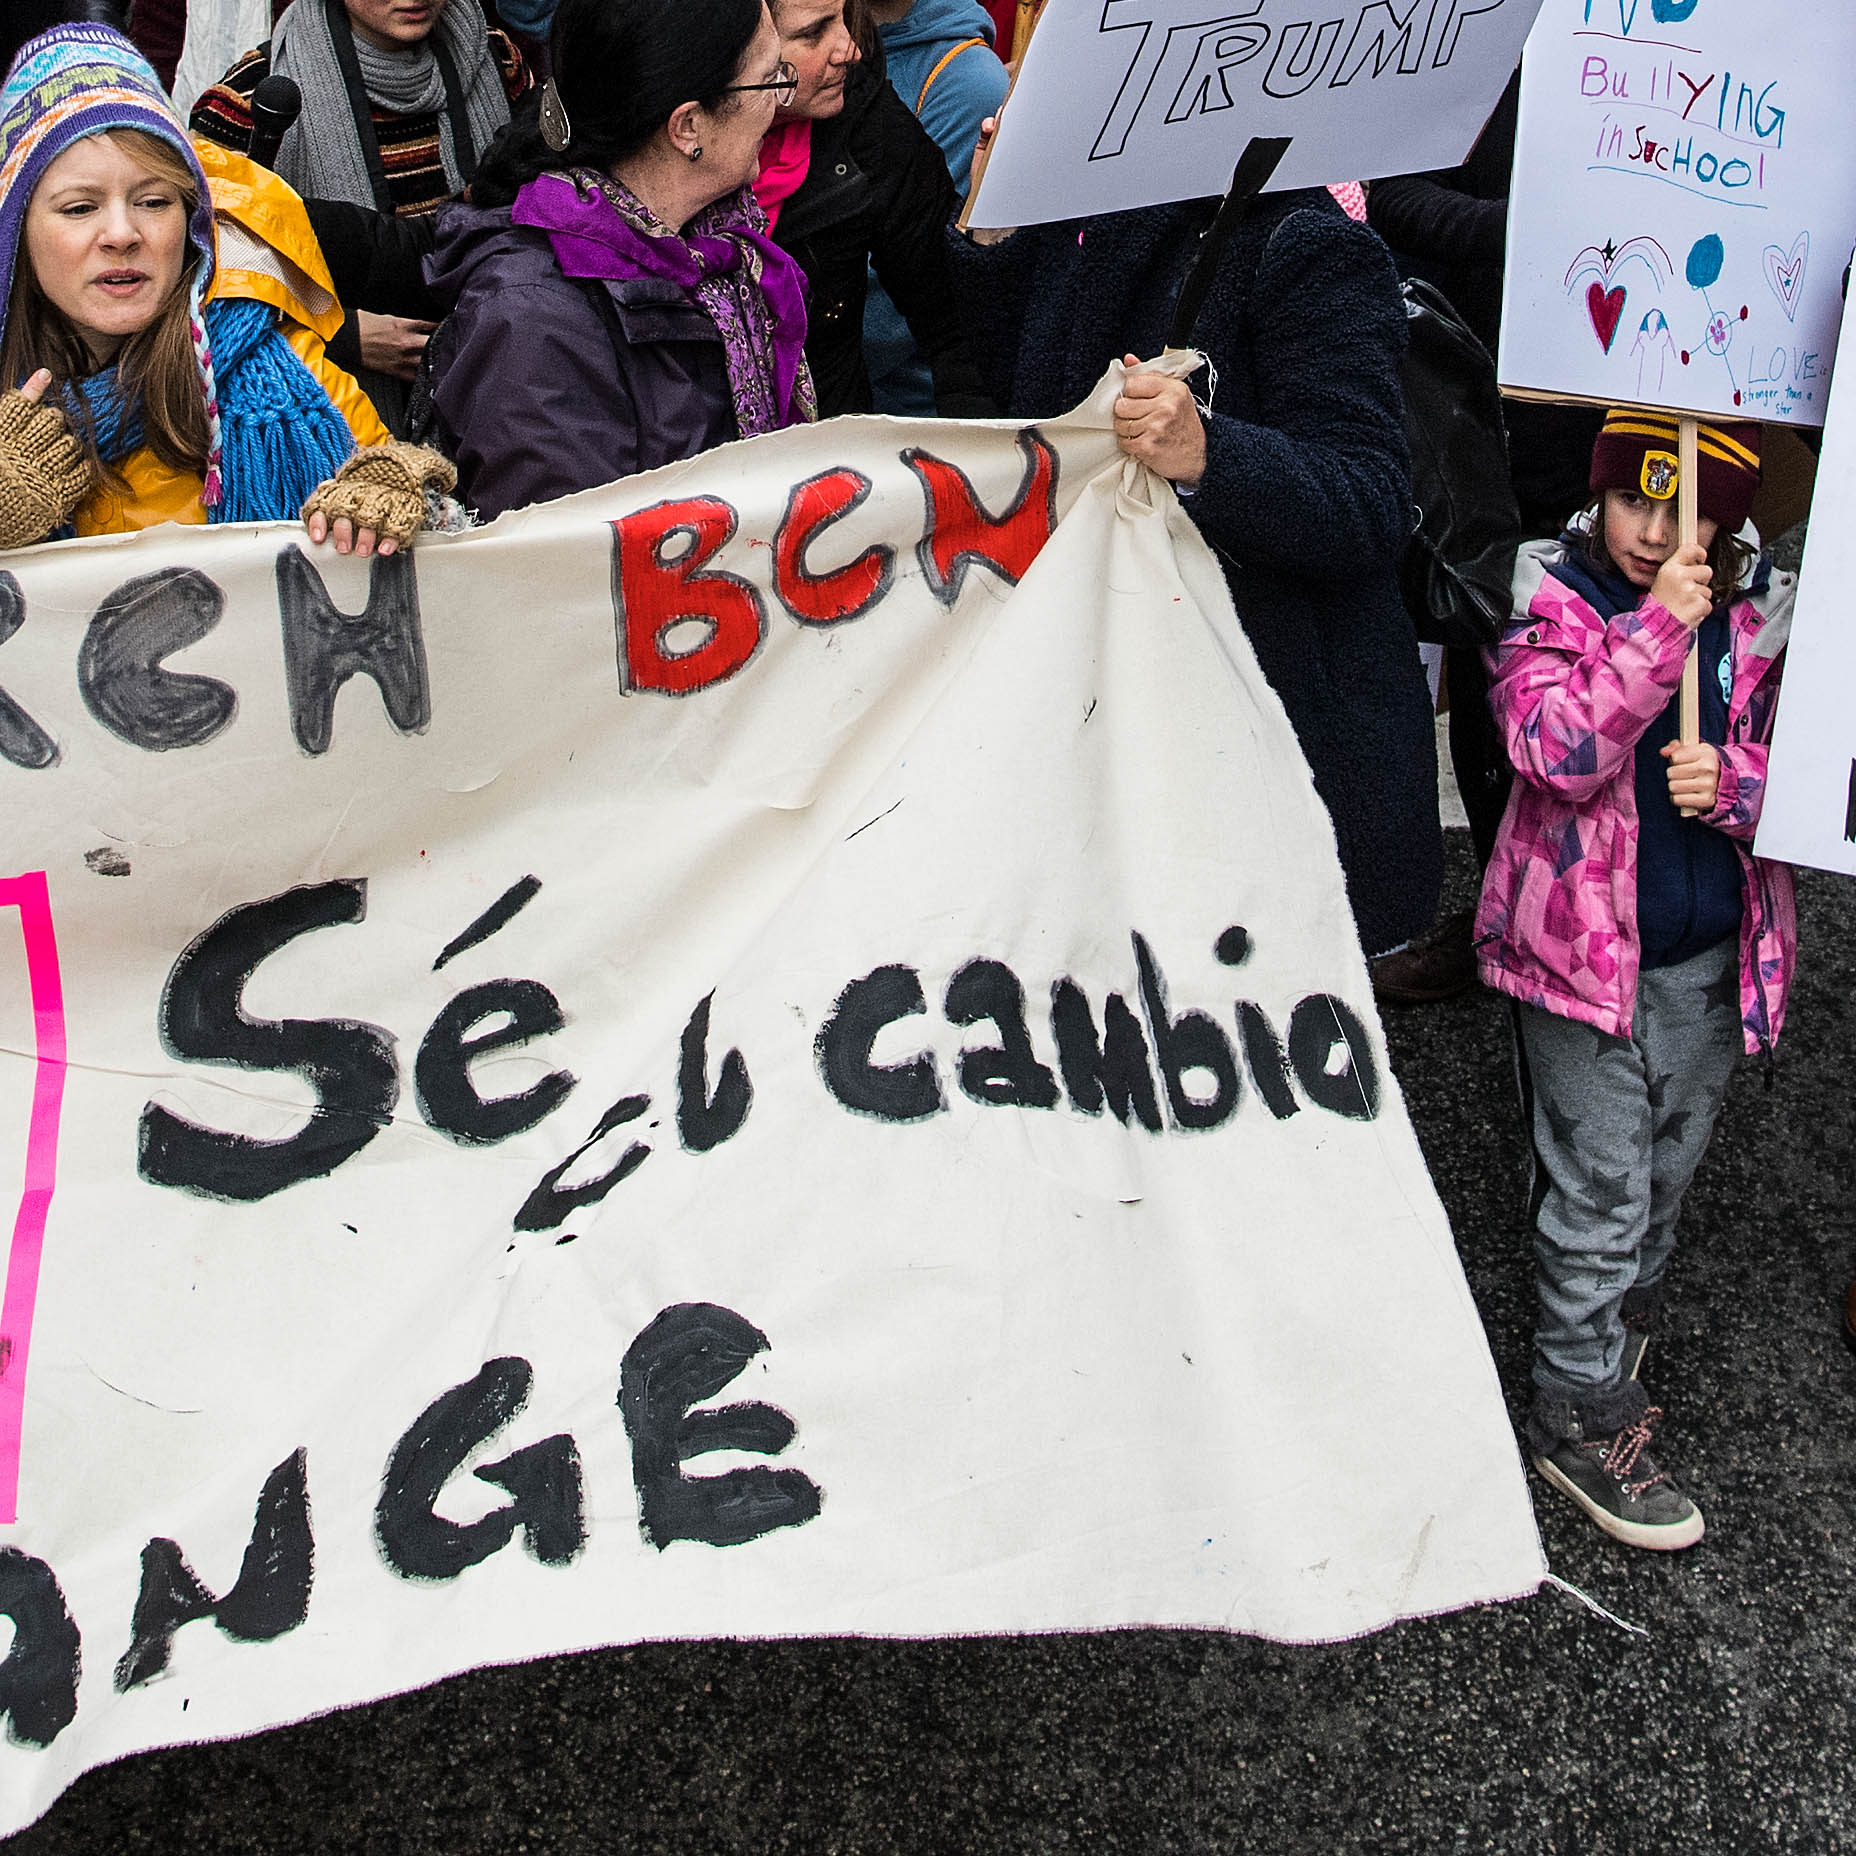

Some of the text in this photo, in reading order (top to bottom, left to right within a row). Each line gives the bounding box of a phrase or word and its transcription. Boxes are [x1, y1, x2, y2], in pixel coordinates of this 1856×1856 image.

[1595, 112, 1624, 160] in
[1747, 345, 1819, 384] LOVE
[1741, 386, 1779, 408] stronger
[609, 425, 1062, 700] BCN
[136, 872, 582, 1204] Sé
[813, 924, 1383, 1132] cambio
